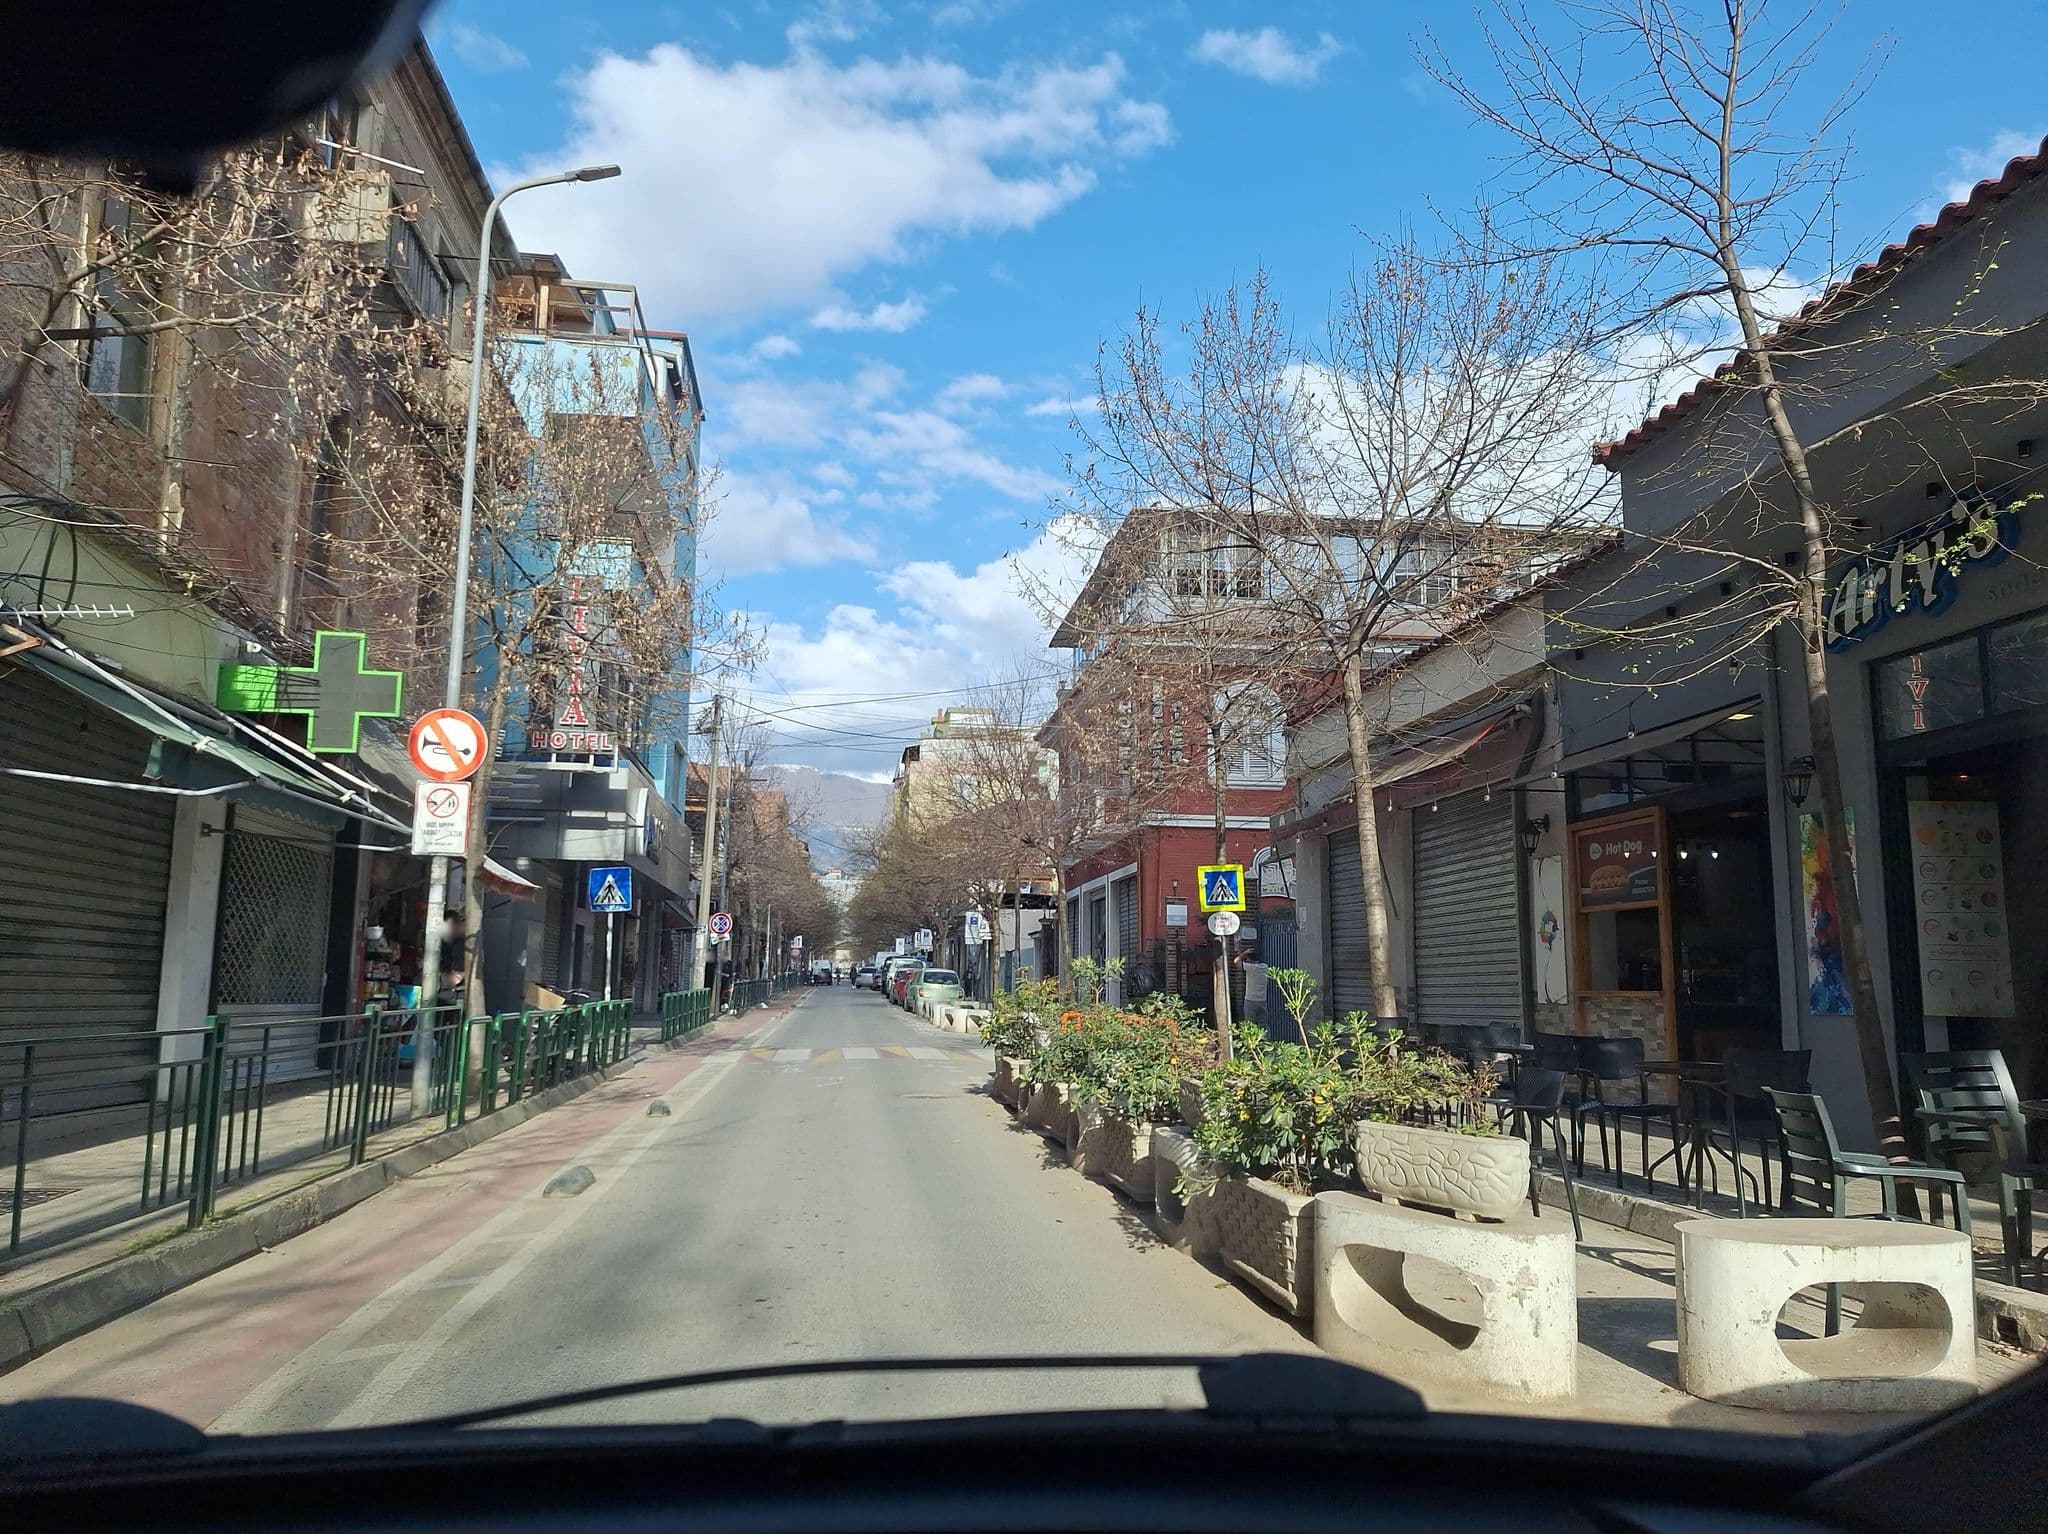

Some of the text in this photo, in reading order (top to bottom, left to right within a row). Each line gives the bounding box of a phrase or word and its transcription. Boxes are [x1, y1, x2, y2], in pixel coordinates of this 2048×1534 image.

[1827, 499, 1999, 645] Arty's
[559, 576, 590, 726] LIVIA
[531, 731, 613, 751] HOTEL
[1605, 842, 1622, 856] Hot
[1623, 840, 1642, 855] Dog
